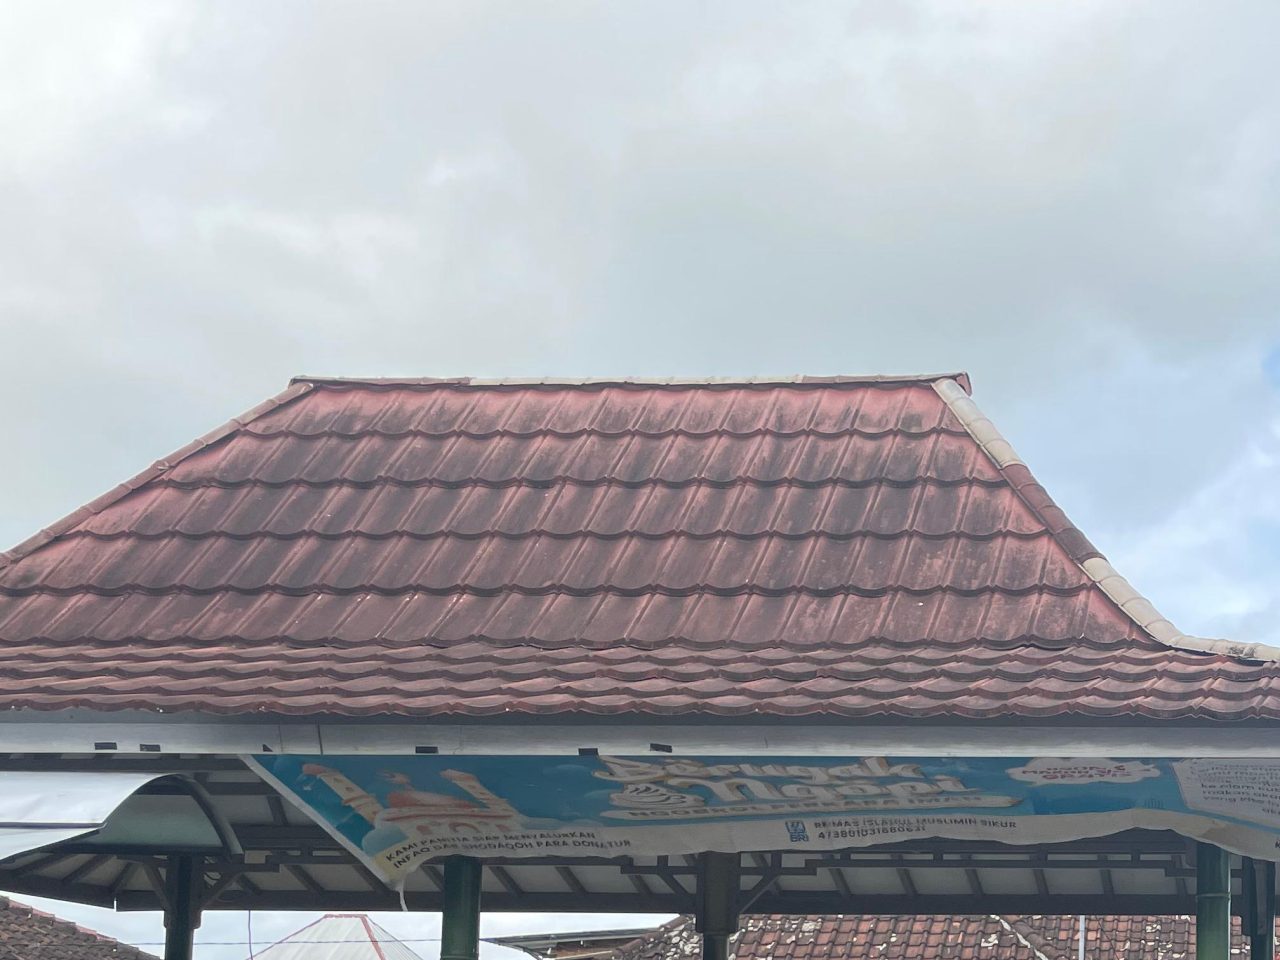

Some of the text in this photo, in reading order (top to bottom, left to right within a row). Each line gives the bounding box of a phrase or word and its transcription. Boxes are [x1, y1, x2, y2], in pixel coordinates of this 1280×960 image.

[386, 842, 418, 862] KAMI
[420, 835, 470, 846] PANITIA
[503, 830, 597, 841] MENYALURKAN
[393, 847, 432, 869] INFAQ
[536, 839, 570, 849] PARA
[571, 838, 633, 850] DONATUR
